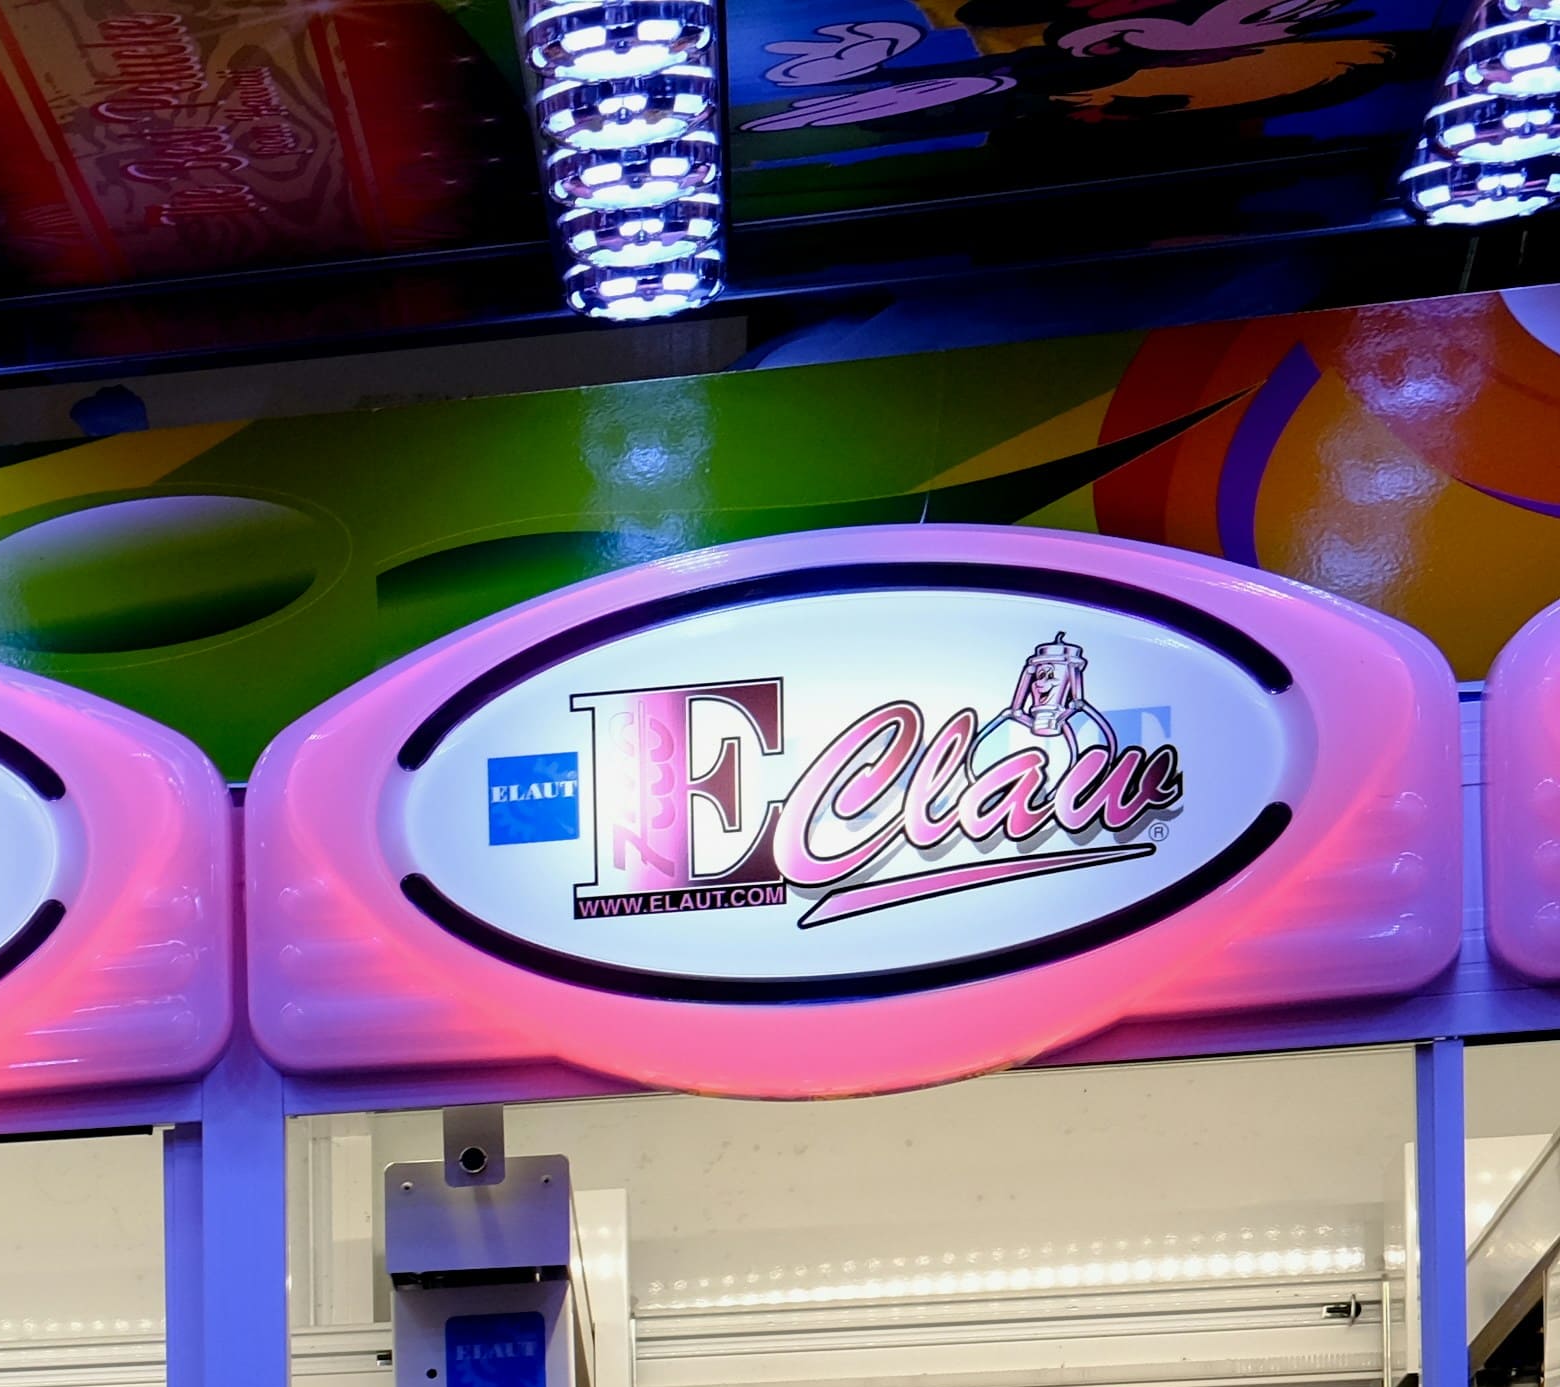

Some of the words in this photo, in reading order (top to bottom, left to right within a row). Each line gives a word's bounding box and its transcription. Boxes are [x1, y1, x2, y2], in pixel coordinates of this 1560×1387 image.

[78, 12, 226, 123] Peluche
[118, 125, 249, 184] Best
[491, 781, 578, 801] ELAUT
[577, 886, 786, 918] WWW.ELAUT.COM
